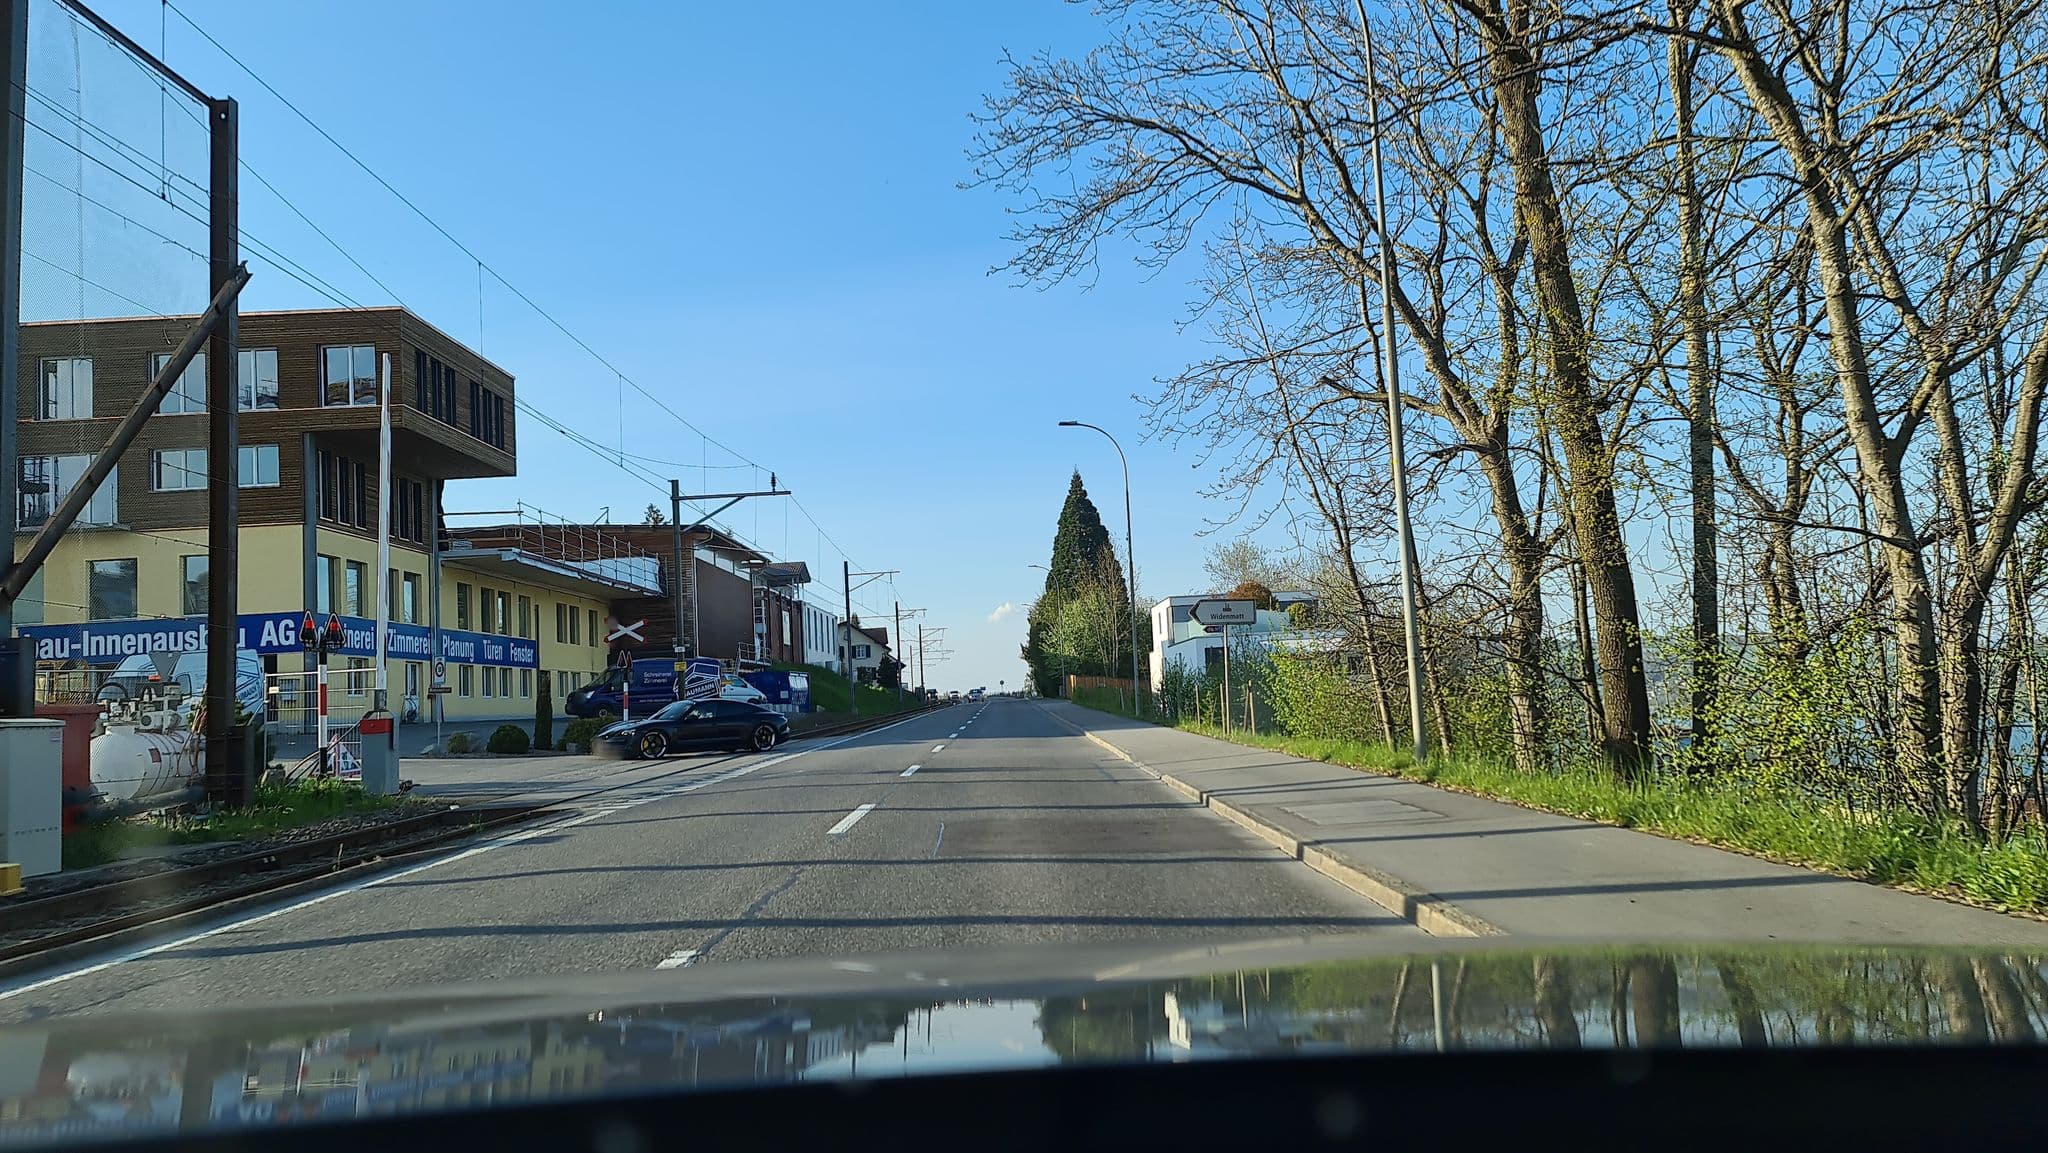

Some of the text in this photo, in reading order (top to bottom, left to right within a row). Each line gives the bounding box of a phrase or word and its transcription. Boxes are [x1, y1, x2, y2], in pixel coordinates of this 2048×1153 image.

[24, 619, 296, 660] au-Innenausbu AG
[387, 628, 431, 655] Zimmerei
[442, 635, 475, 663] Planung
[482, 639, 503, 661] Türen
[510, 642, 534, 663] Fenster
[686, 682, 716, 697] AUMANN
